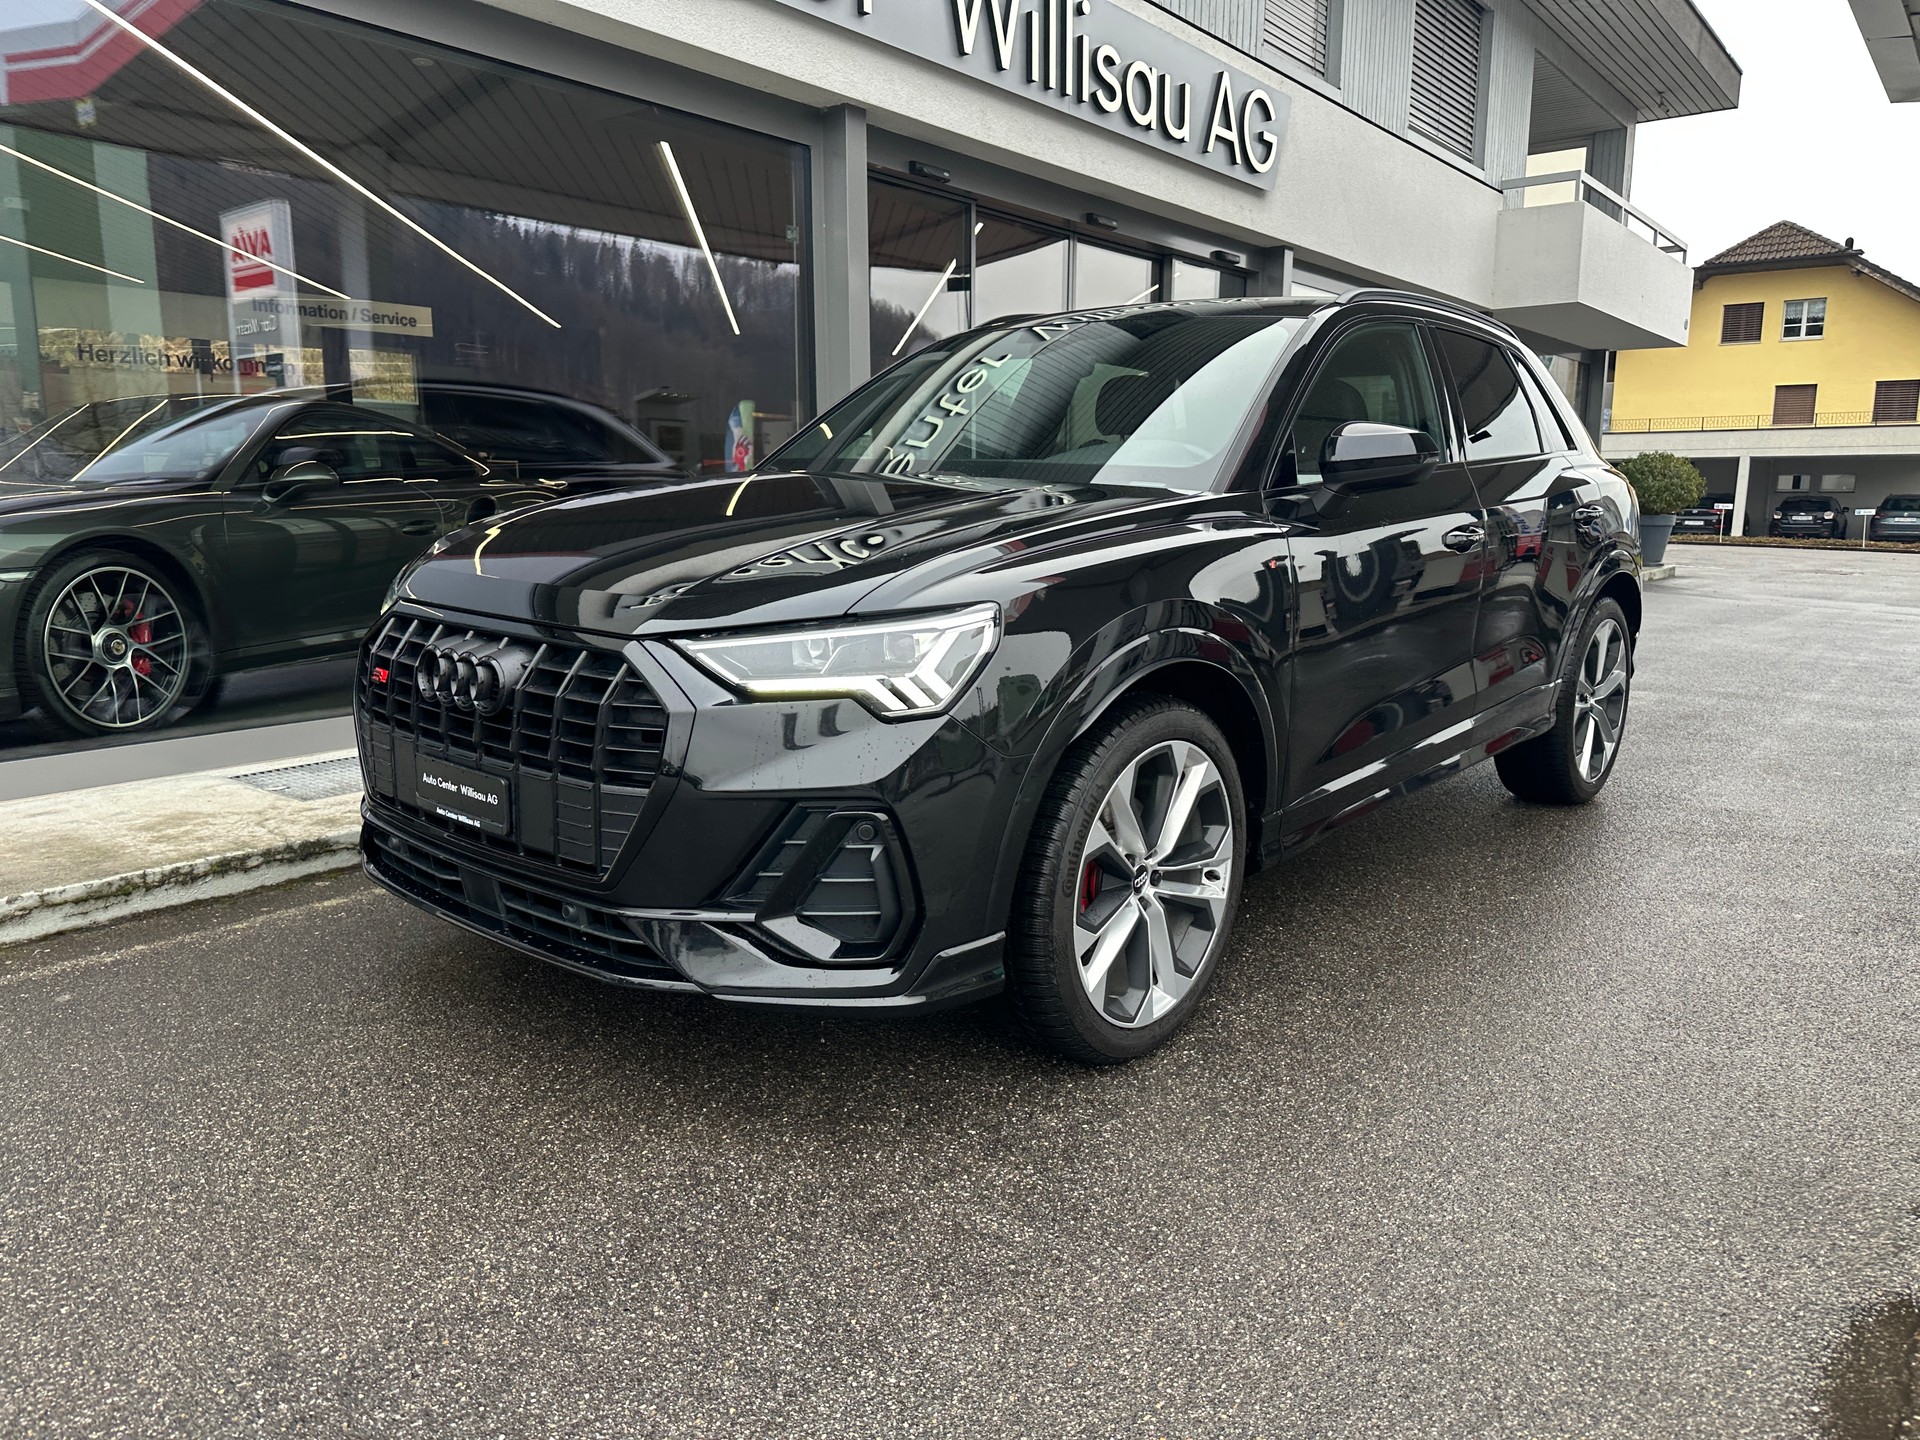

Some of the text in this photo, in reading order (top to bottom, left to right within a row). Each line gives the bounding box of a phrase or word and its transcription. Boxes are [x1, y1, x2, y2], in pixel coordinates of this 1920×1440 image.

[953, 0, 1278, 174] Willisau AG
[252, 297, 348, 321] Information
[361, 307, 417, 328] Service
[77, 343, 170, 369] Herzlich
[423, 772, 498, 805] Auto Center Willisau AG
[1062, 795, 1100, 898] Continental
